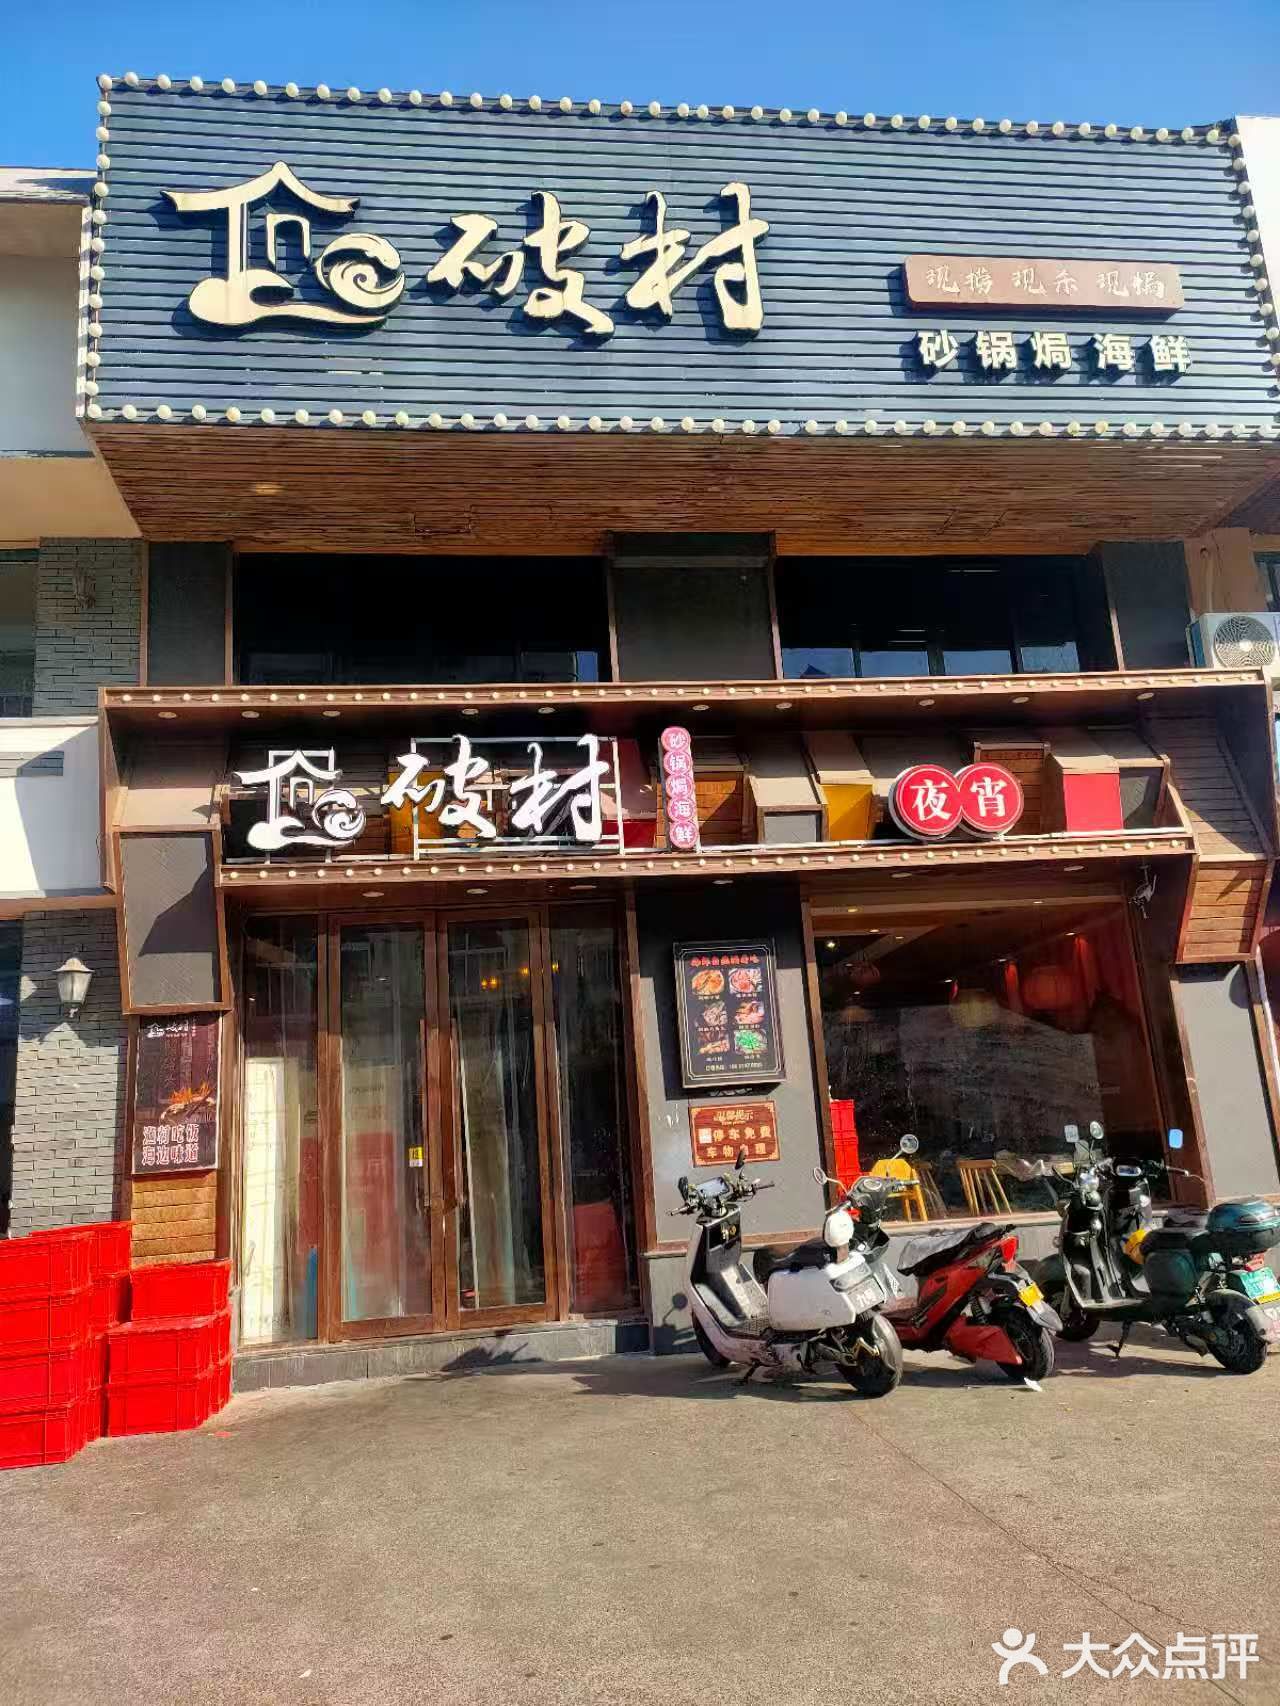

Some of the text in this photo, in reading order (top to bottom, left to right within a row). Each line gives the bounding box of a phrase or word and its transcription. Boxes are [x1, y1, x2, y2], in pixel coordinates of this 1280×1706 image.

[917, 329, 1192, 374] 砂锅焗海鲜
[665, 731, 694, 846] 砂锅焗海鲜
[909, 776, 1008, 821] 夜宵
